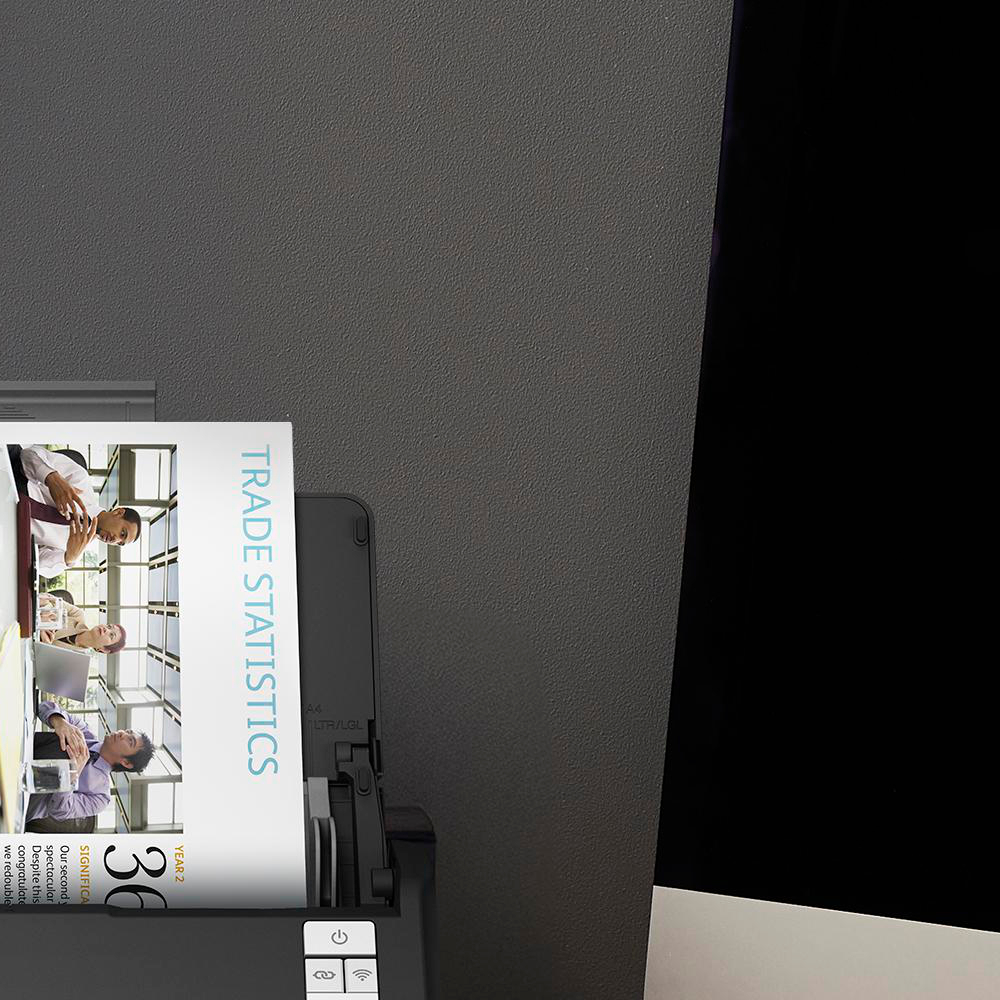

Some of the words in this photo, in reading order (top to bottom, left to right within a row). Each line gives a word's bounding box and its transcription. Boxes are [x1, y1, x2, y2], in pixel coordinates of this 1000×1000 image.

[241, 445, 272, 562] TRADE
[243, 573, 278, 776] STATISTICS
[3, 845, 12, 857] we
[30, 845, 42, 884] Despite
[60, 845, 70, 864] Our
[174, 845, 185, 876] YEAR
[44, 845, 57, 903] spectacular
[60, 865, 71, 901] second
[32, 886, 42, 904] this
